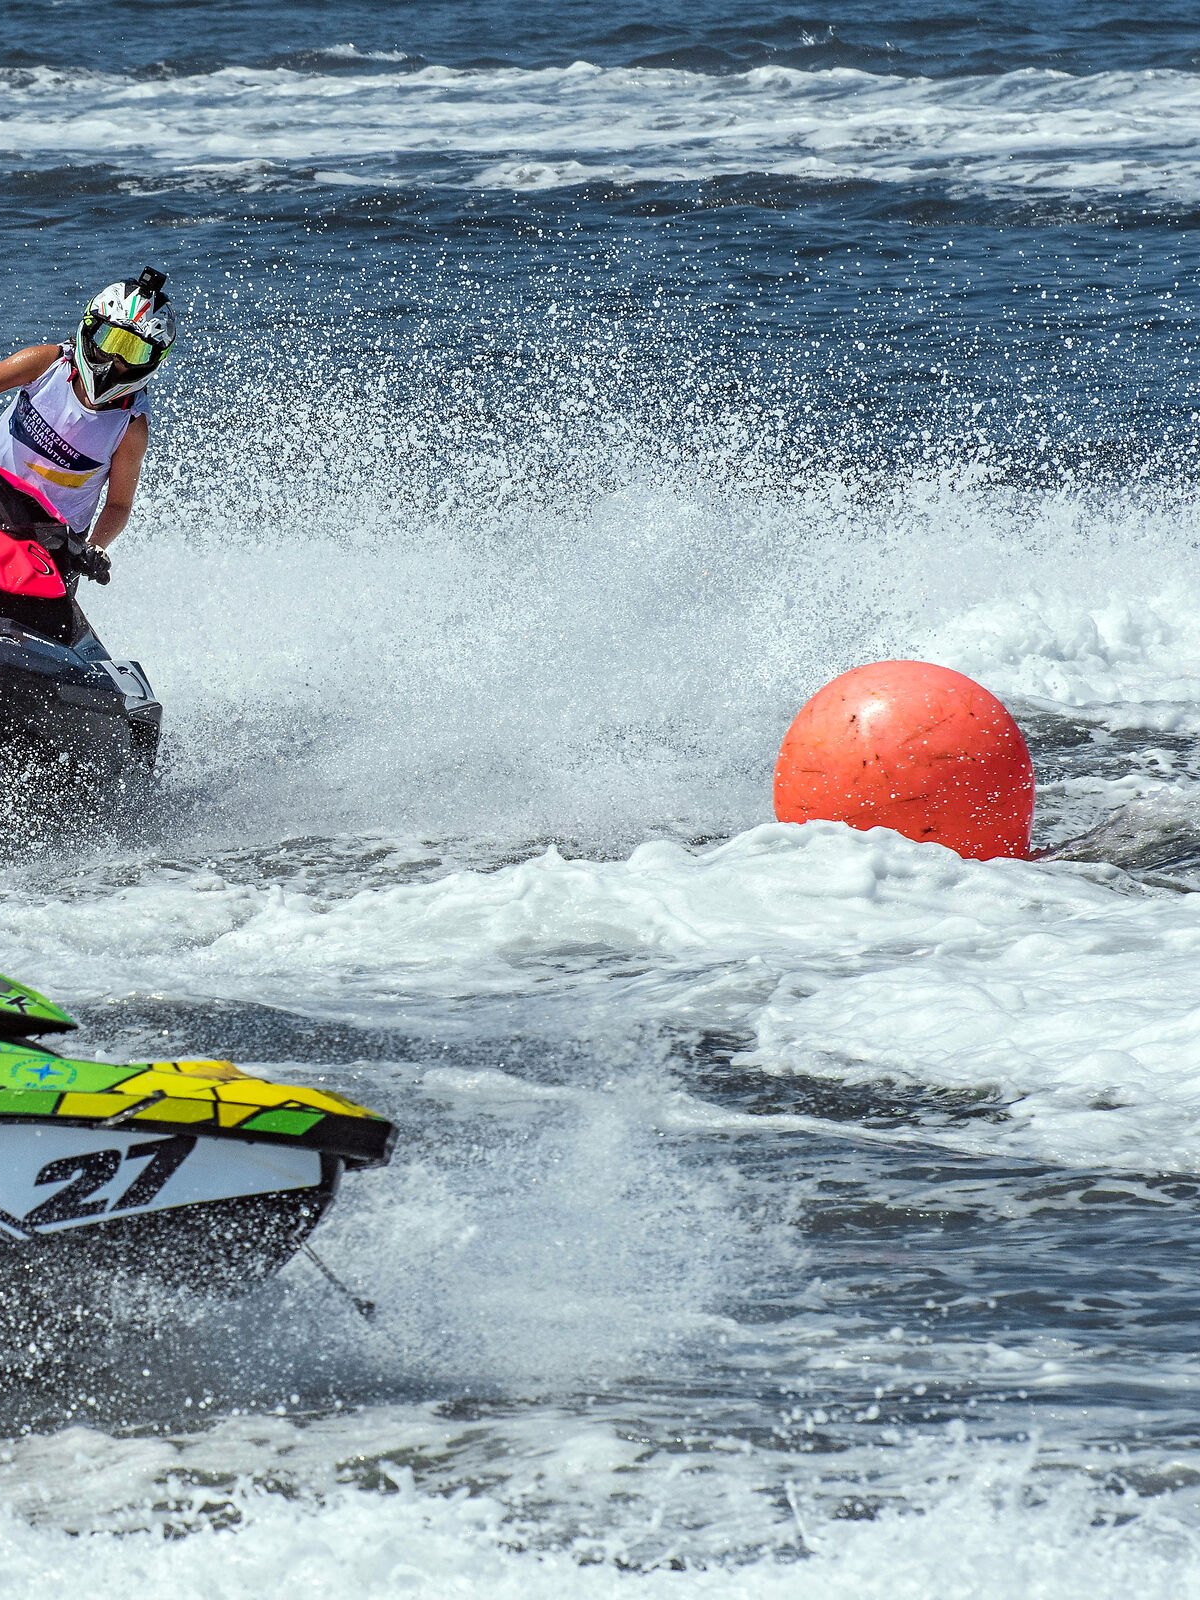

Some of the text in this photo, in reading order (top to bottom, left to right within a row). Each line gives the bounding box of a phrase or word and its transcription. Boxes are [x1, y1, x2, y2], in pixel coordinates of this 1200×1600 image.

[22, 419, 72, 469] MOTONAUTICA
[24, 414, 56, 449] ITALIANA
[28, 408, 82, 460] FEDERAZIONE
[23, 1133, 198, 1227] 27
